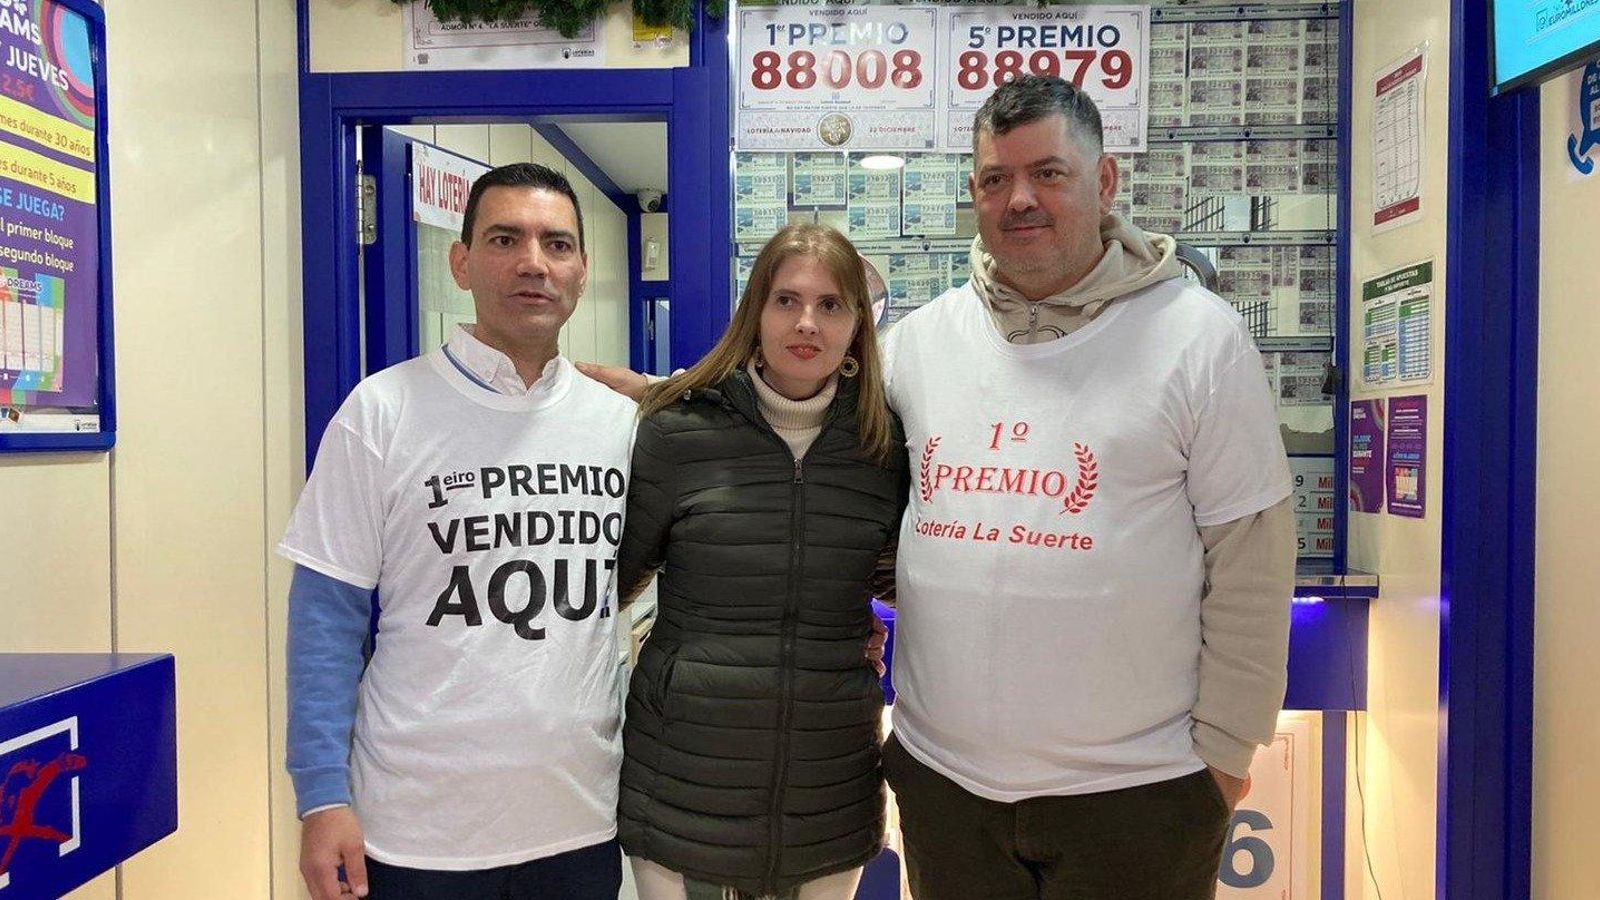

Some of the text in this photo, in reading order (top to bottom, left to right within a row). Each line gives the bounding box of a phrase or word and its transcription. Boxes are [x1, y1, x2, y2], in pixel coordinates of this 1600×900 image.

[1012, 11, 1078, 20] VENDIDO AQUÍ
[766, 22, 909, 46] 1er PREMIO
[968, 25, 1121, 49] 5º PREMIO
[7, 46, 69, 91] JUEVES
[751, 49, 923, 91] 88008
[957, 49, 1133, 90] 88979
[19, 118, 53, 144] durante
[55, 132, 68, 148] 30
[69, 138, 91, 157] años
[11, 160, 48, 184] durante
[49, 172, 55, 187] 5
[56, 174, 77, 194] años
[419, 163, 436, 206] HAY
[16, 193, 65, 221] JUEGA?
[7, 221, 43, 241] primer
[45, 227, 74, 250] bloque
[0, 247, 74, 273] segundo bloque
[7, 277, 42, 292] DREAMS
[990, 421, 1029, 450] 1º
[425, 463, 625, 509] 1eiro PREMIO
[934, 464, 1068, 497] PREMIO
[1295, 474, 1304, 488] 9
[1298, 495, 1306, 508] 2
[427, 510, 622, 554] VENDIDO
[973, 522, 1000, 542] La
[1009, 525, 1093, 551] Suerte
[1297, 537, 1306, 550] 5
